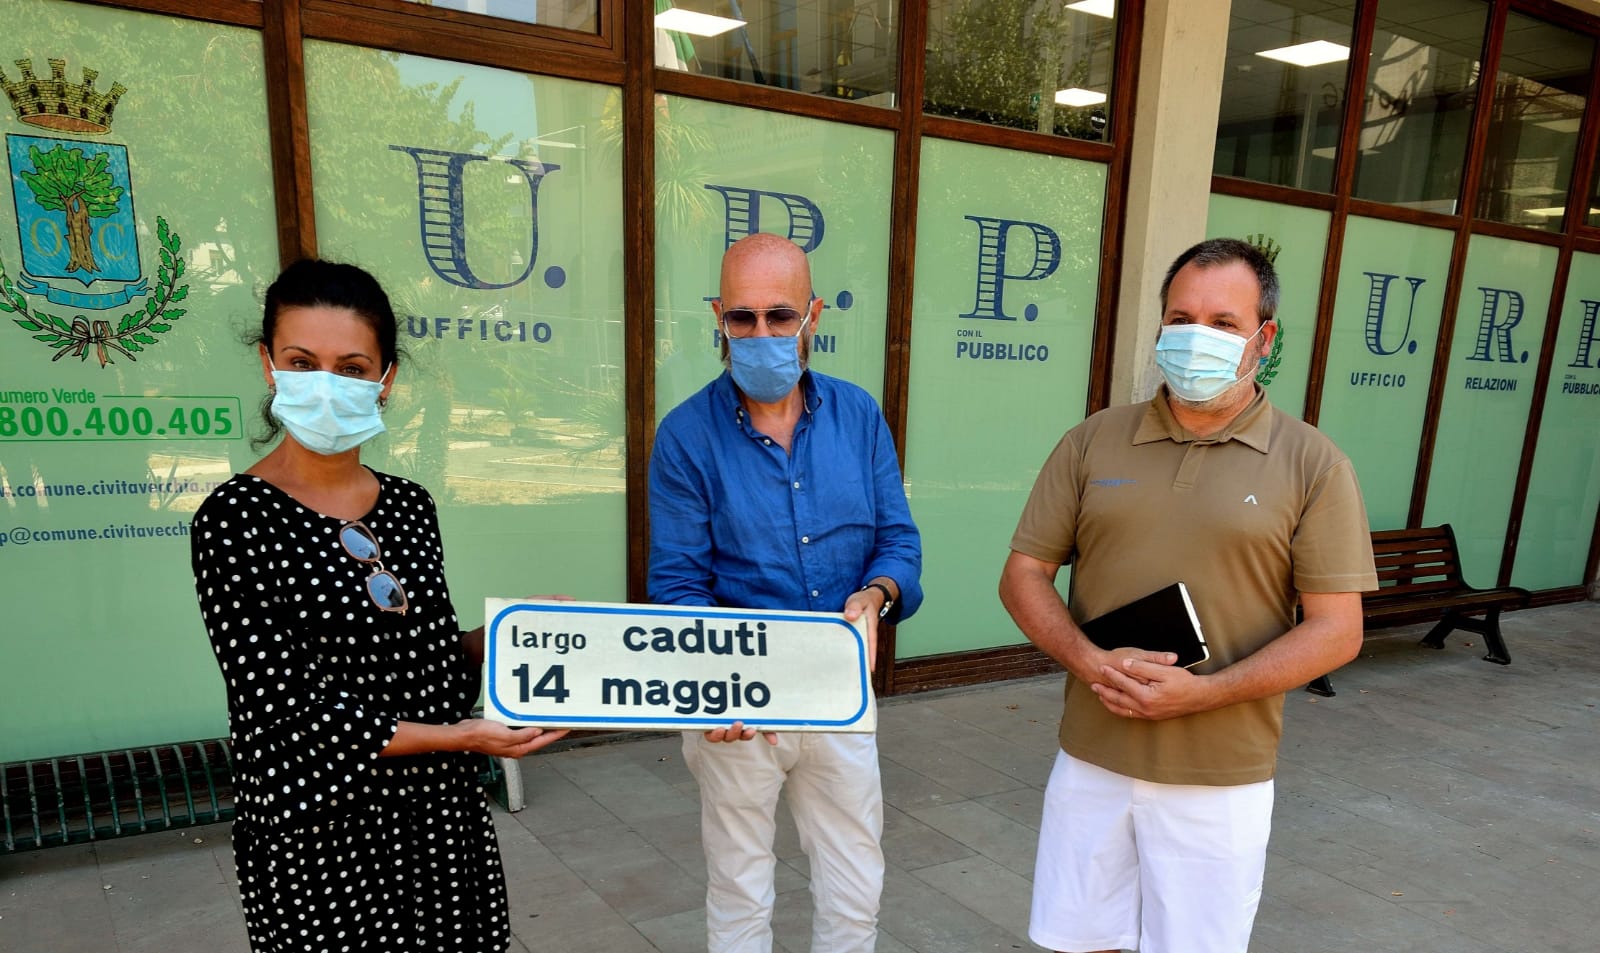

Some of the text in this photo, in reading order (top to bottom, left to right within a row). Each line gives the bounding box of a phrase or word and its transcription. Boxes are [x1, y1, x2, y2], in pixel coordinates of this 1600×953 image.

[959, 215, 1061, 322] P.
[1363, 271, 1426, 356] U.
[1465, 286, 1529, 364] R.
[407, 315, 552, 343] UFFICIO
[957, 329, 983, 338] CON IL
[956, 341, 1049, 362] PUBBLICO
[1350, 371, 1406, 388] UFFICIO
[1465, 376, 1518, 392] RELAZIONI
[1562, 382, 1600, 395] PUBBLIC
[52, 388, 96, 404] Verde
[0, 406, 233, 437] 800.400.405
[511, 619, 768, 657] largo caduti
[511, 662, 771, 715] 14 maggio
